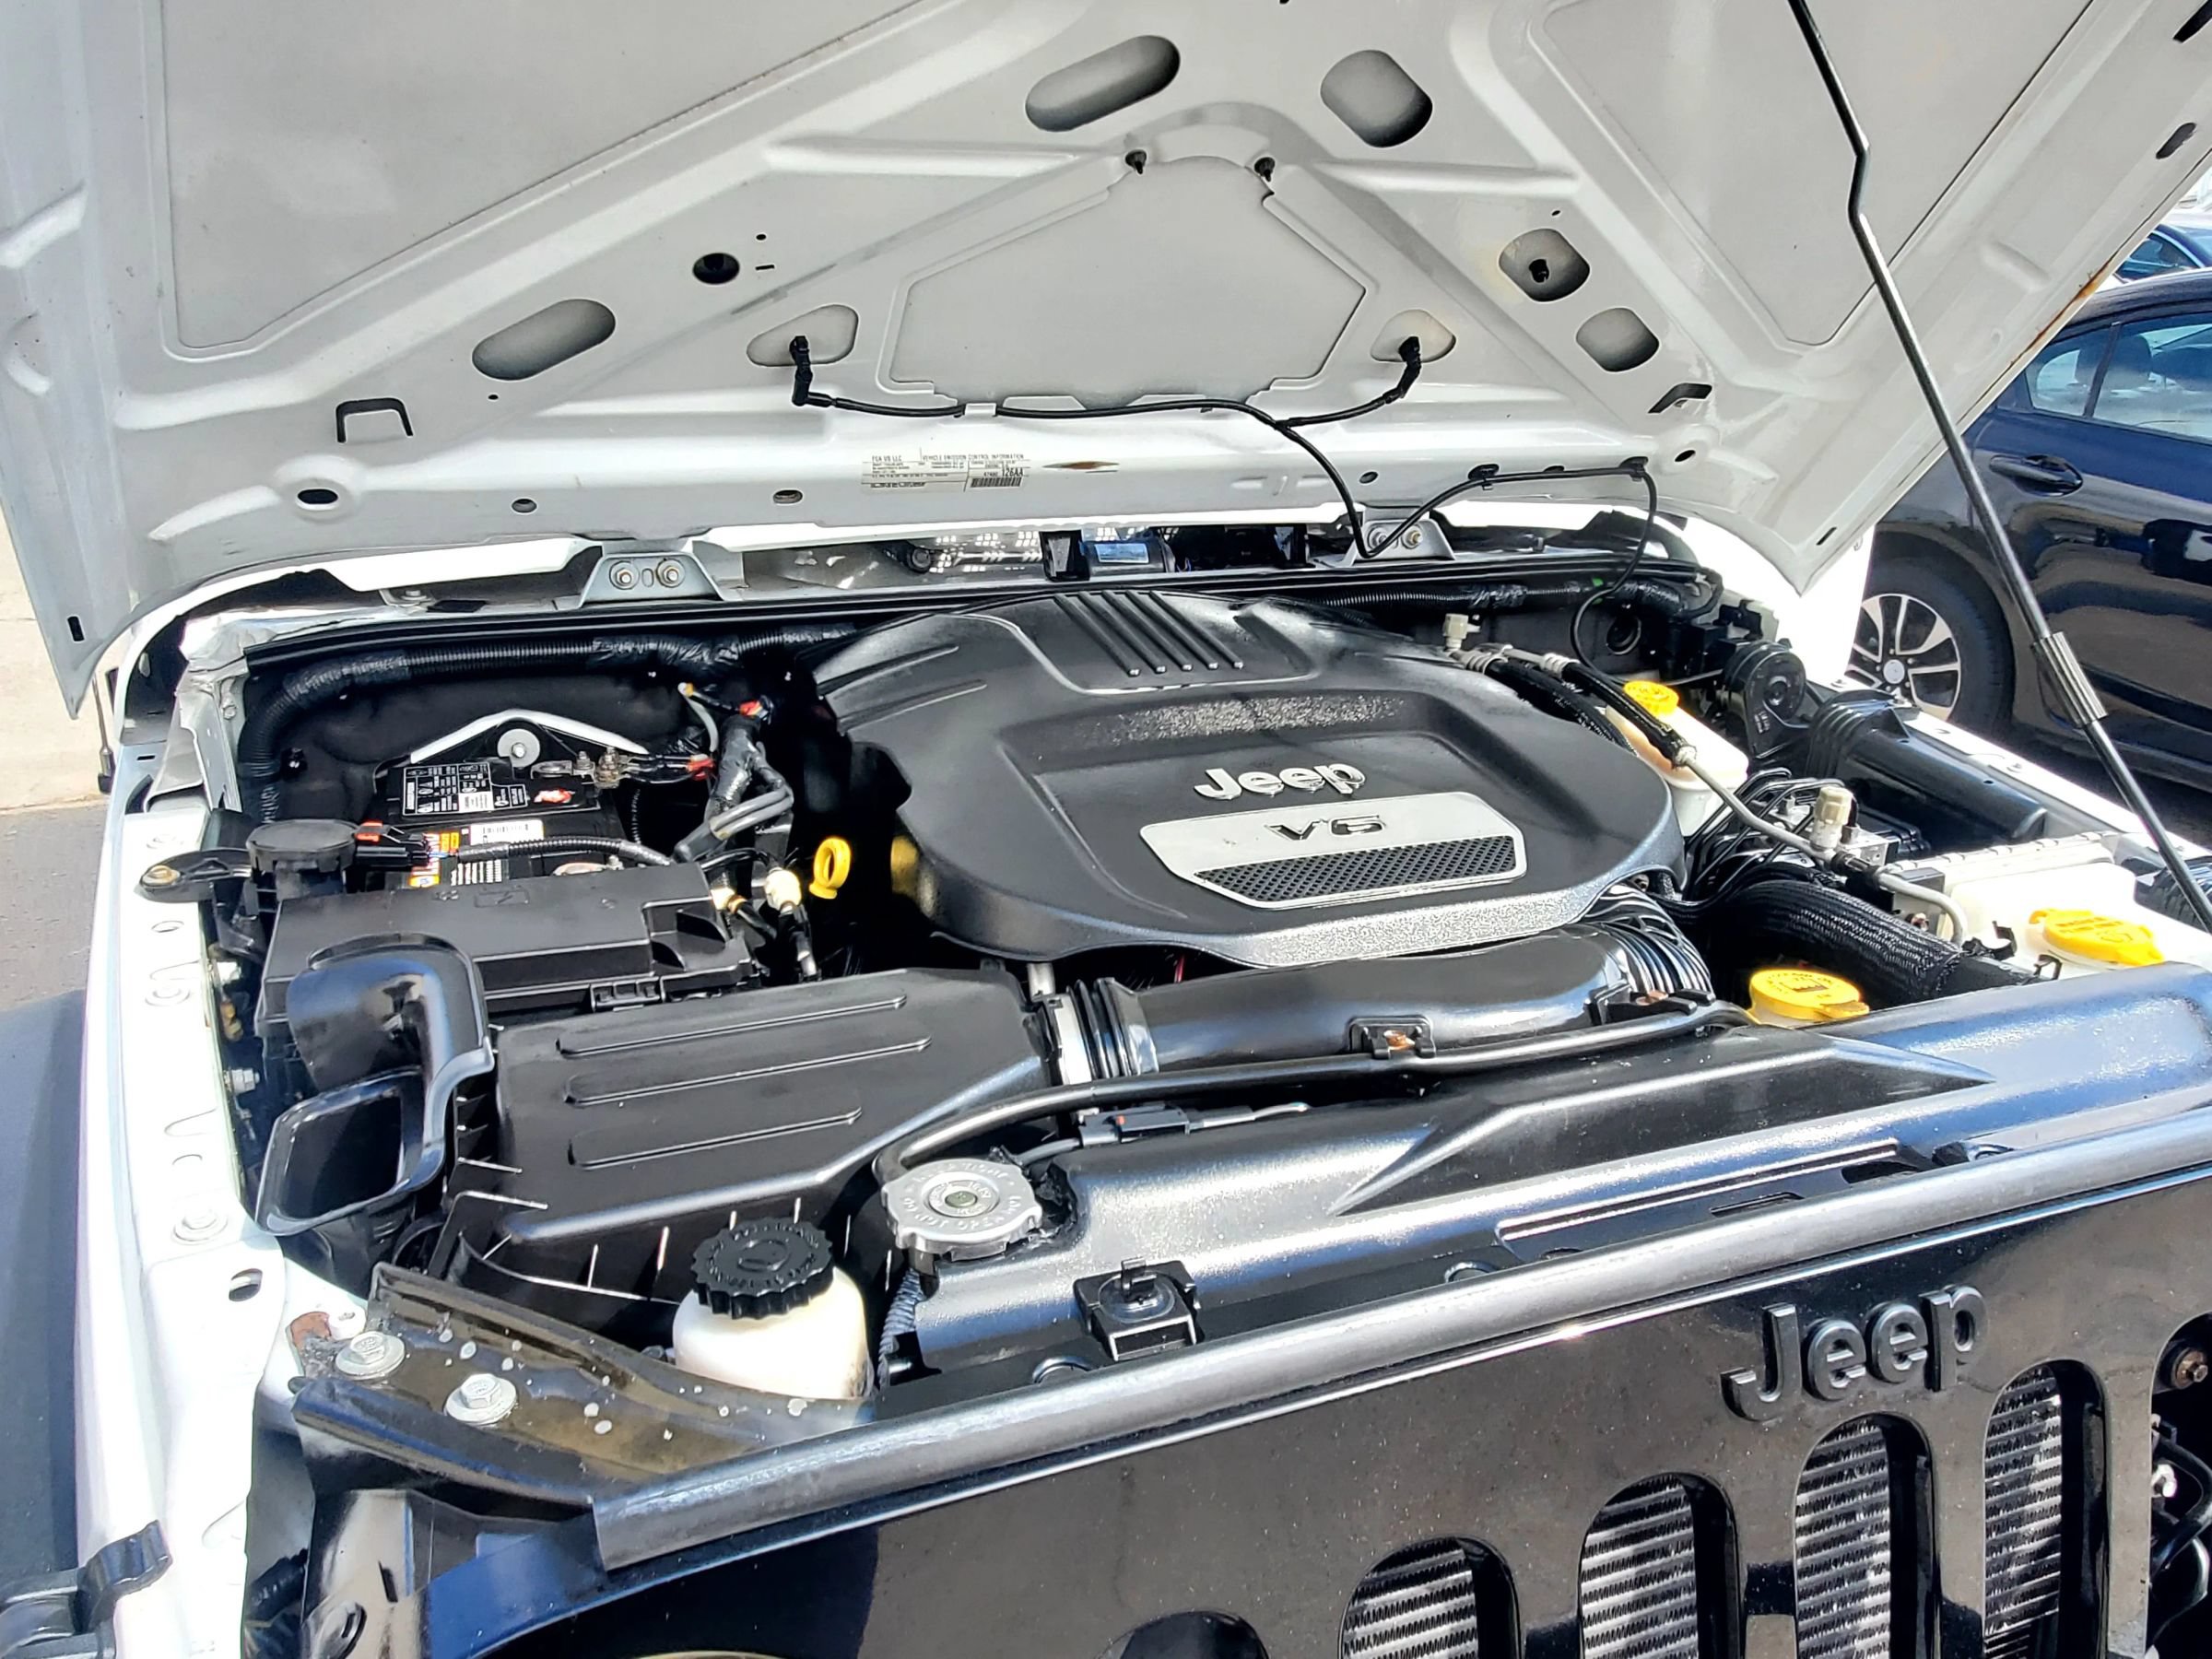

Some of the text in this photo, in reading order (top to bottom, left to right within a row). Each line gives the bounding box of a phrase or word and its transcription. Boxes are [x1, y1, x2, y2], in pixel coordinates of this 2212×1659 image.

[1194, 762, 1366, 800] Jeep
[1265, 813, 1386, 841] V6
[1720, 1284, 1989, 1421] Jeep
